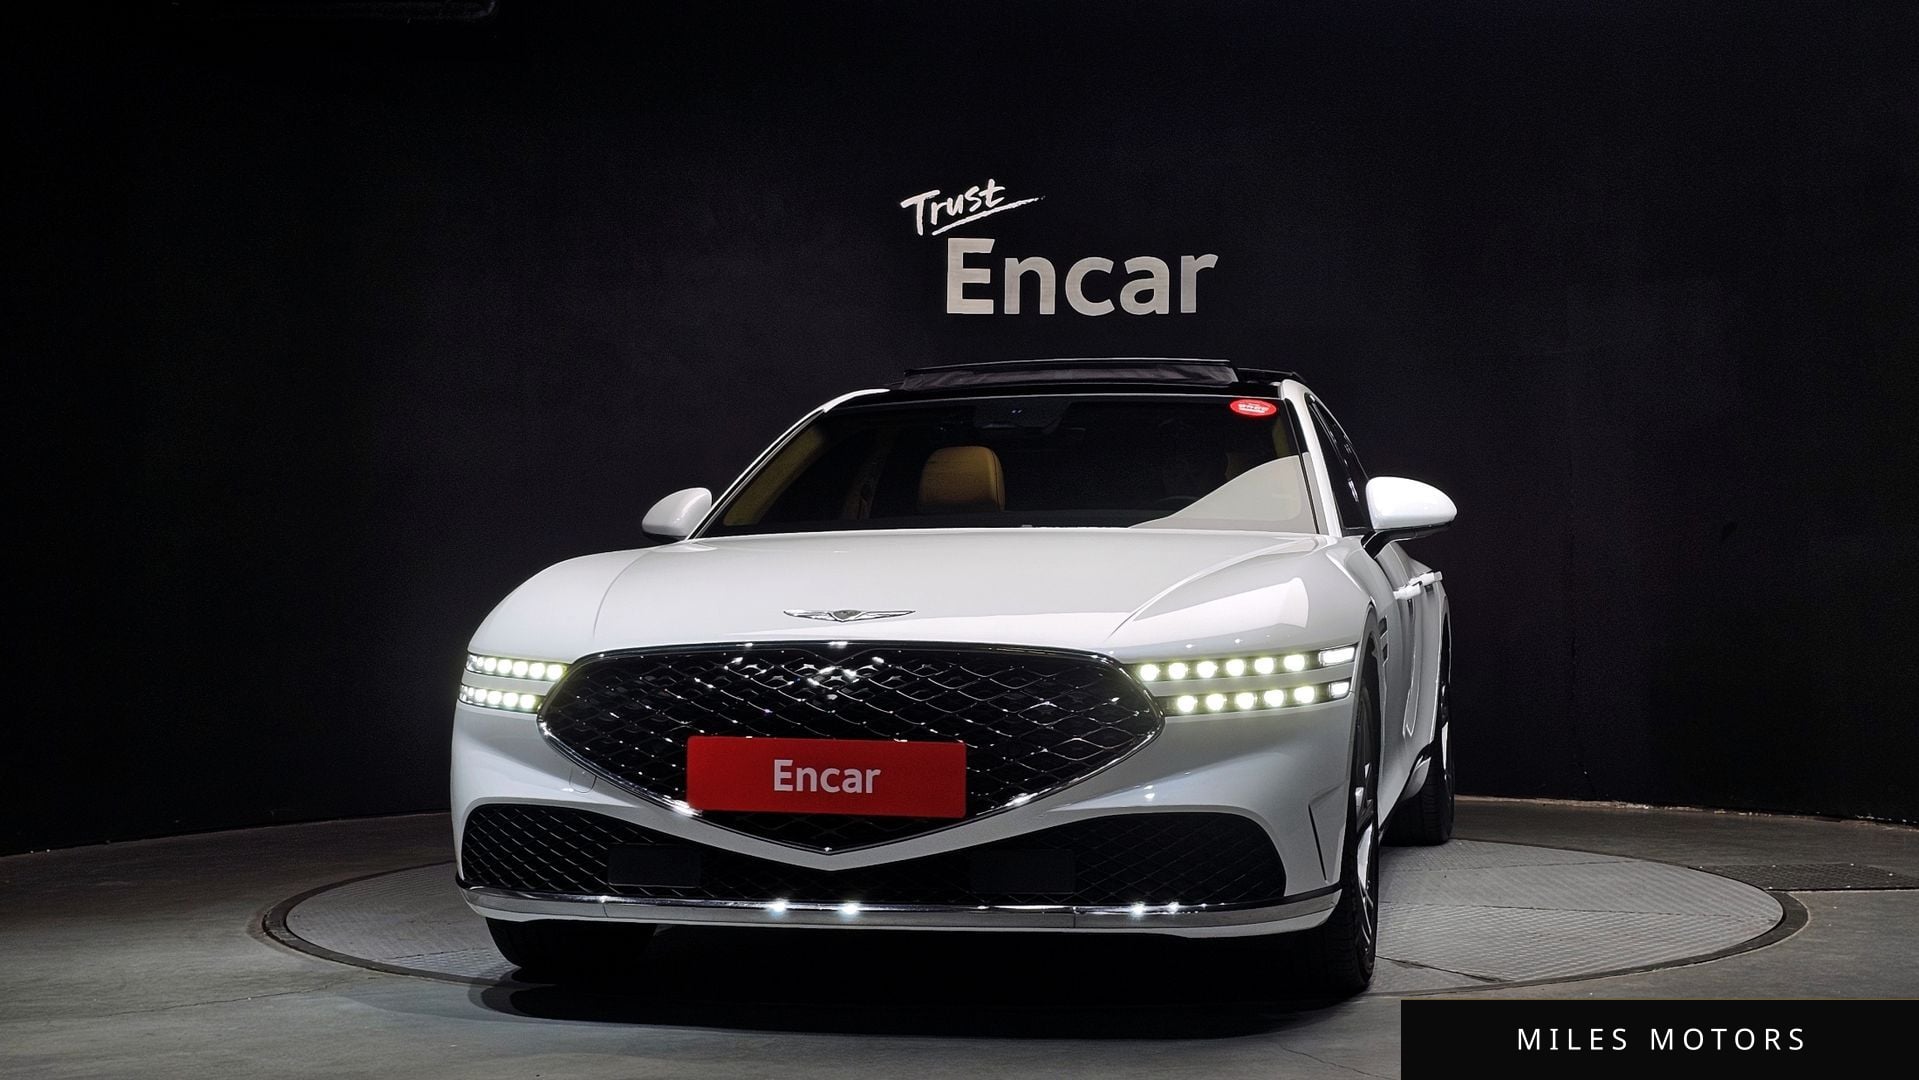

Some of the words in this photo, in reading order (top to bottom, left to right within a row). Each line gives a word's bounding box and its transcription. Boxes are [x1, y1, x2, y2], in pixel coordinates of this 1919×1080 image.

[900, 178, 1006, 236] Trust
[946, 237, 1219, 316] Encar
[772, 758, 882, 795] Encar
